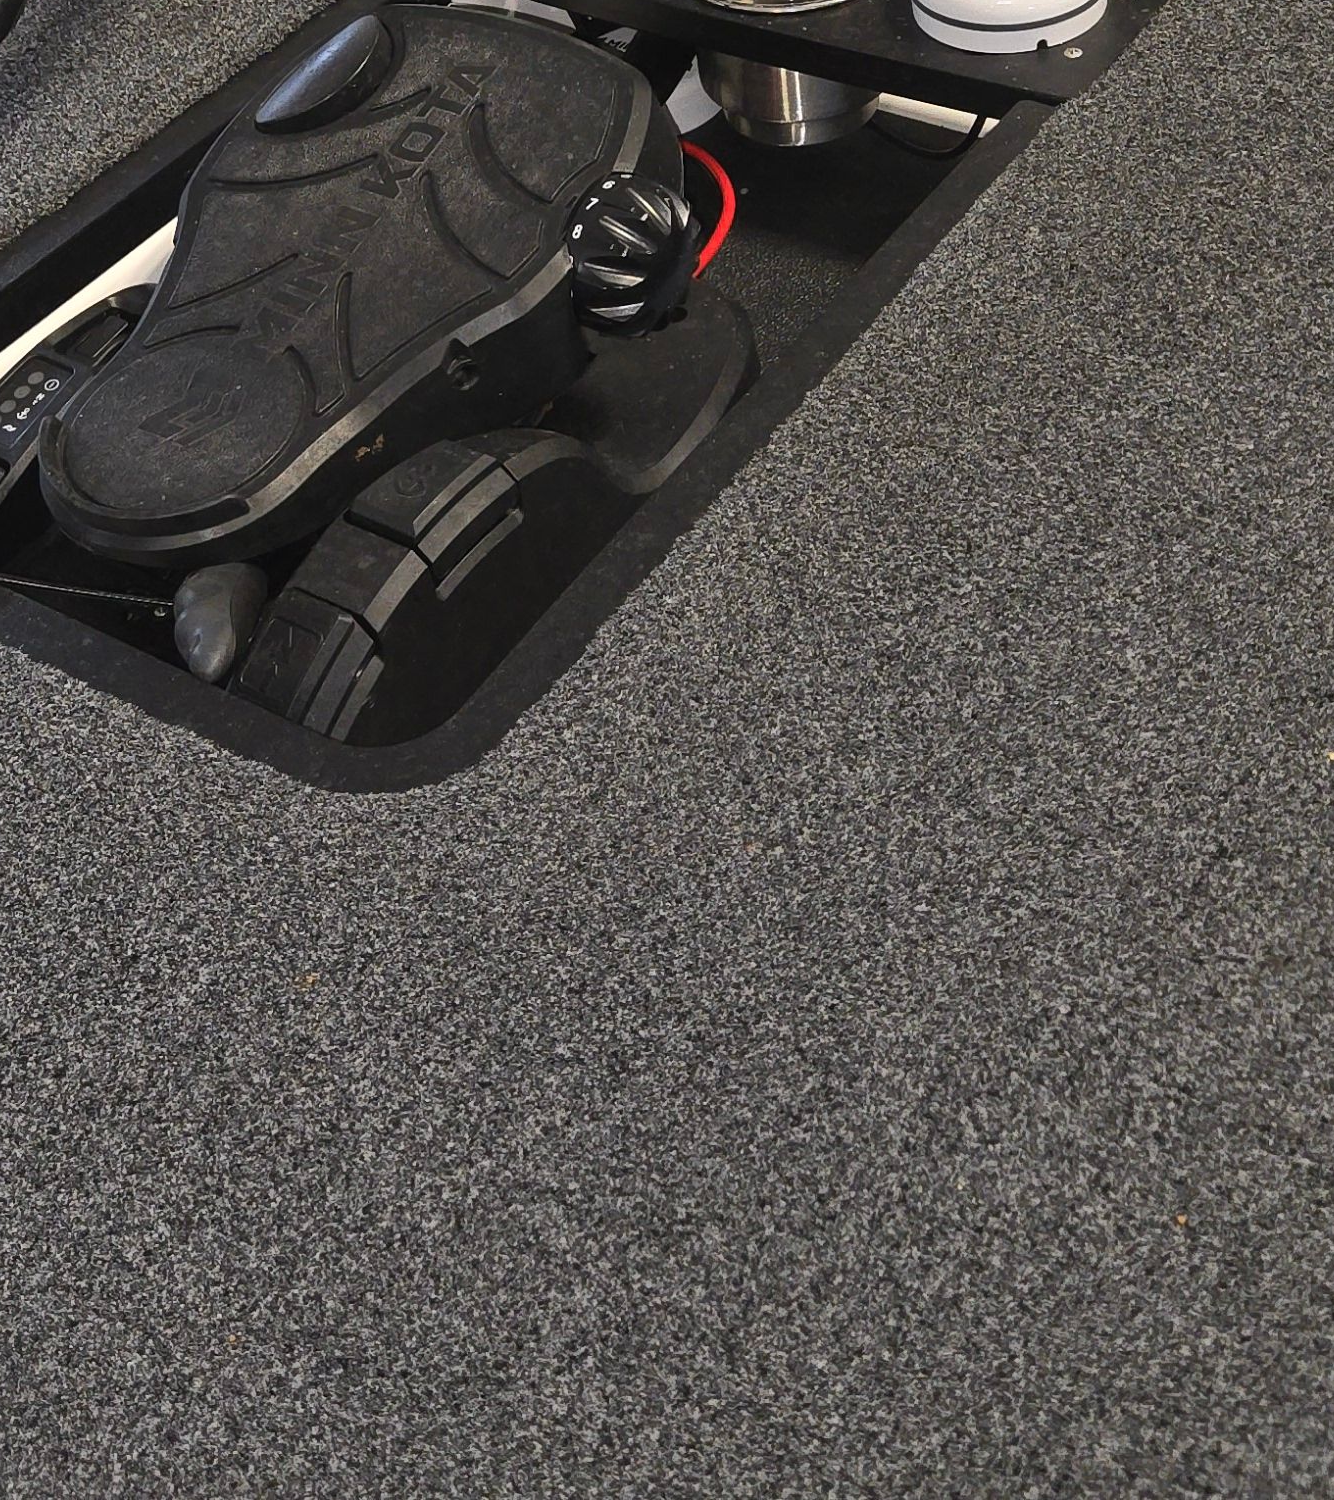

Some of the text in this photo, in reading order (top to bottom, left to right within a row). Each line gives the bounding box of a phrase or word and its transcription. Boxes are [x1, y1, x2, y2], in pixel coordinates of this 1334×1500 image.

[361, 64, 501, 200] KOTA
[602, 180, 616, 190] 6
[585, 197, 600, 211] 7
[571, 224, 583, 240] 8
